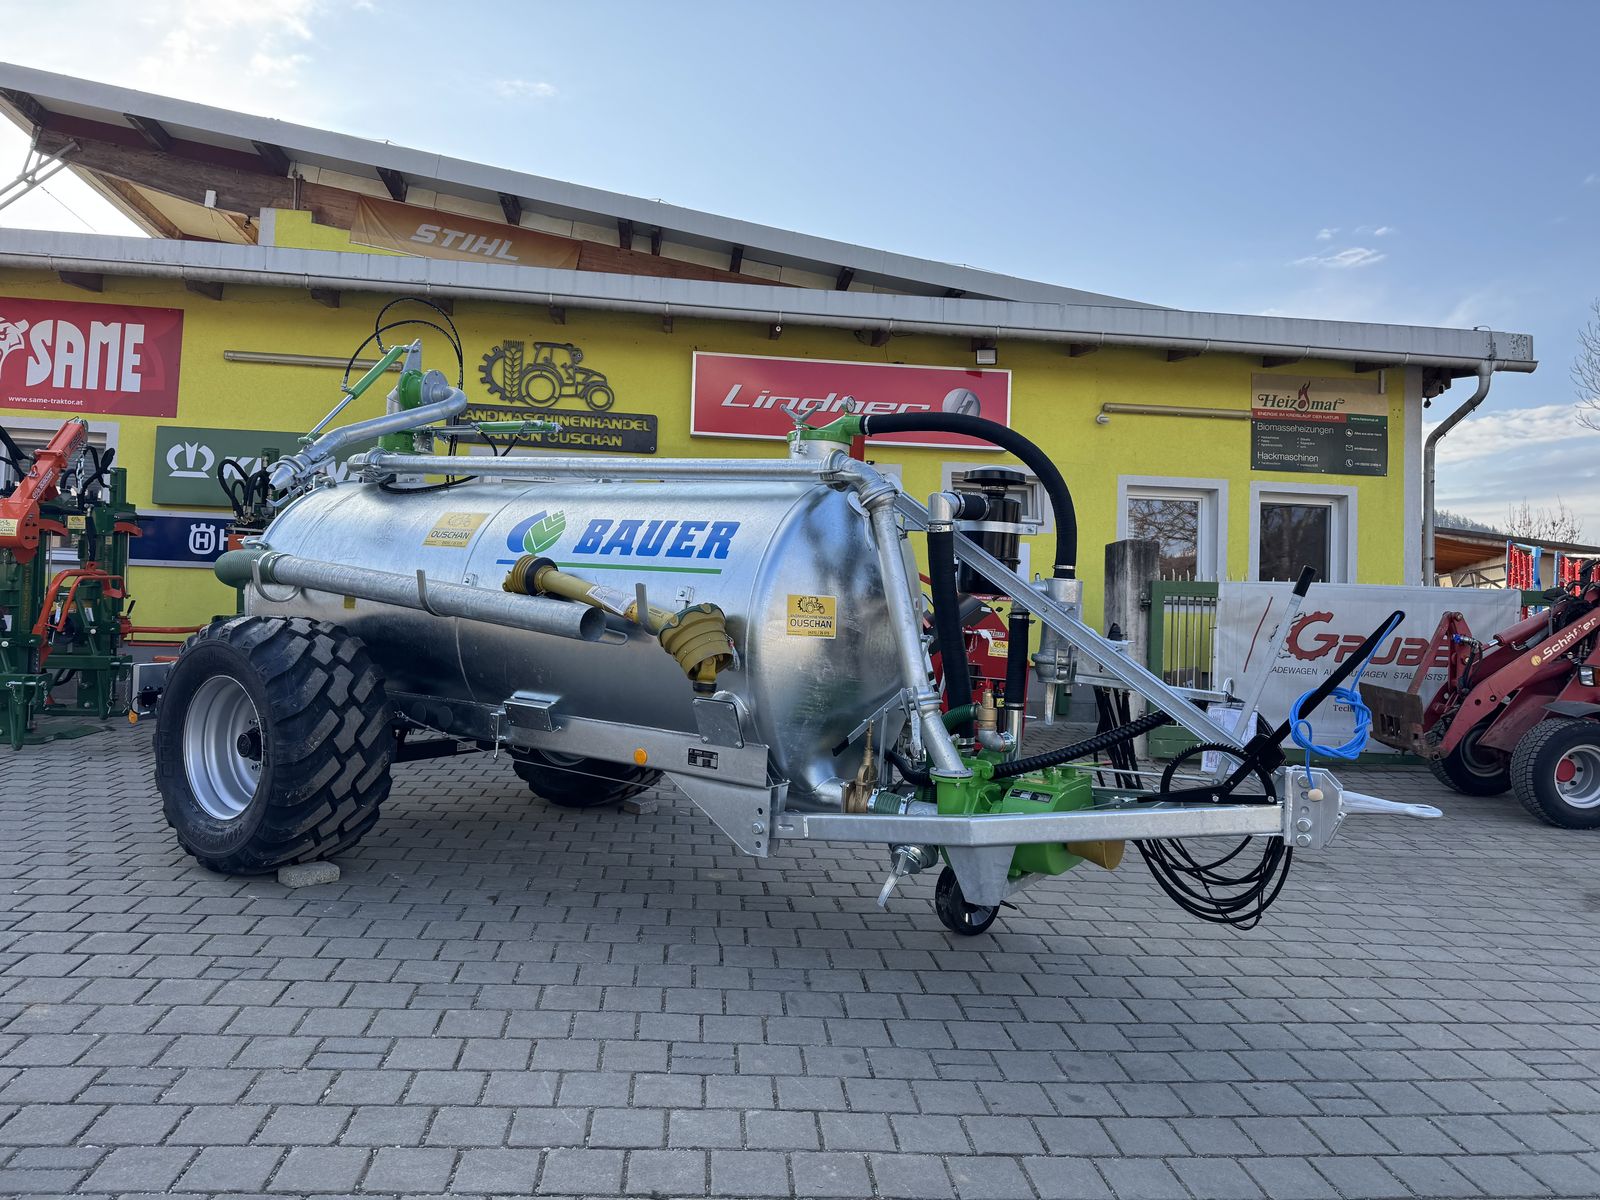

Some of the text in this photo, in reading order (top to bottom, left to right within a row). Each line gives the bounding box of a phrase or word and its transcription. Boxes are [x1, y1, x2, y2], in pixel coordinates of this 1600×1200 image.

[410, 223, 520, 261] STIHL
[25, 319, 145, 393] SAME
[8, 395, 84, 407] www.same-traktor.at
[1257, 422, 1335, 435] Biomasseheizungen
[1257, 451, 1319, 463] Hackmaschinen
[430, 530, 471, 540] OUSCHAN
[572, 518, 741, 560] BAUER
[790, 618, 832, 629] OUSCHAN
[1270, 665, 1318, 676] ADEWAGEN
